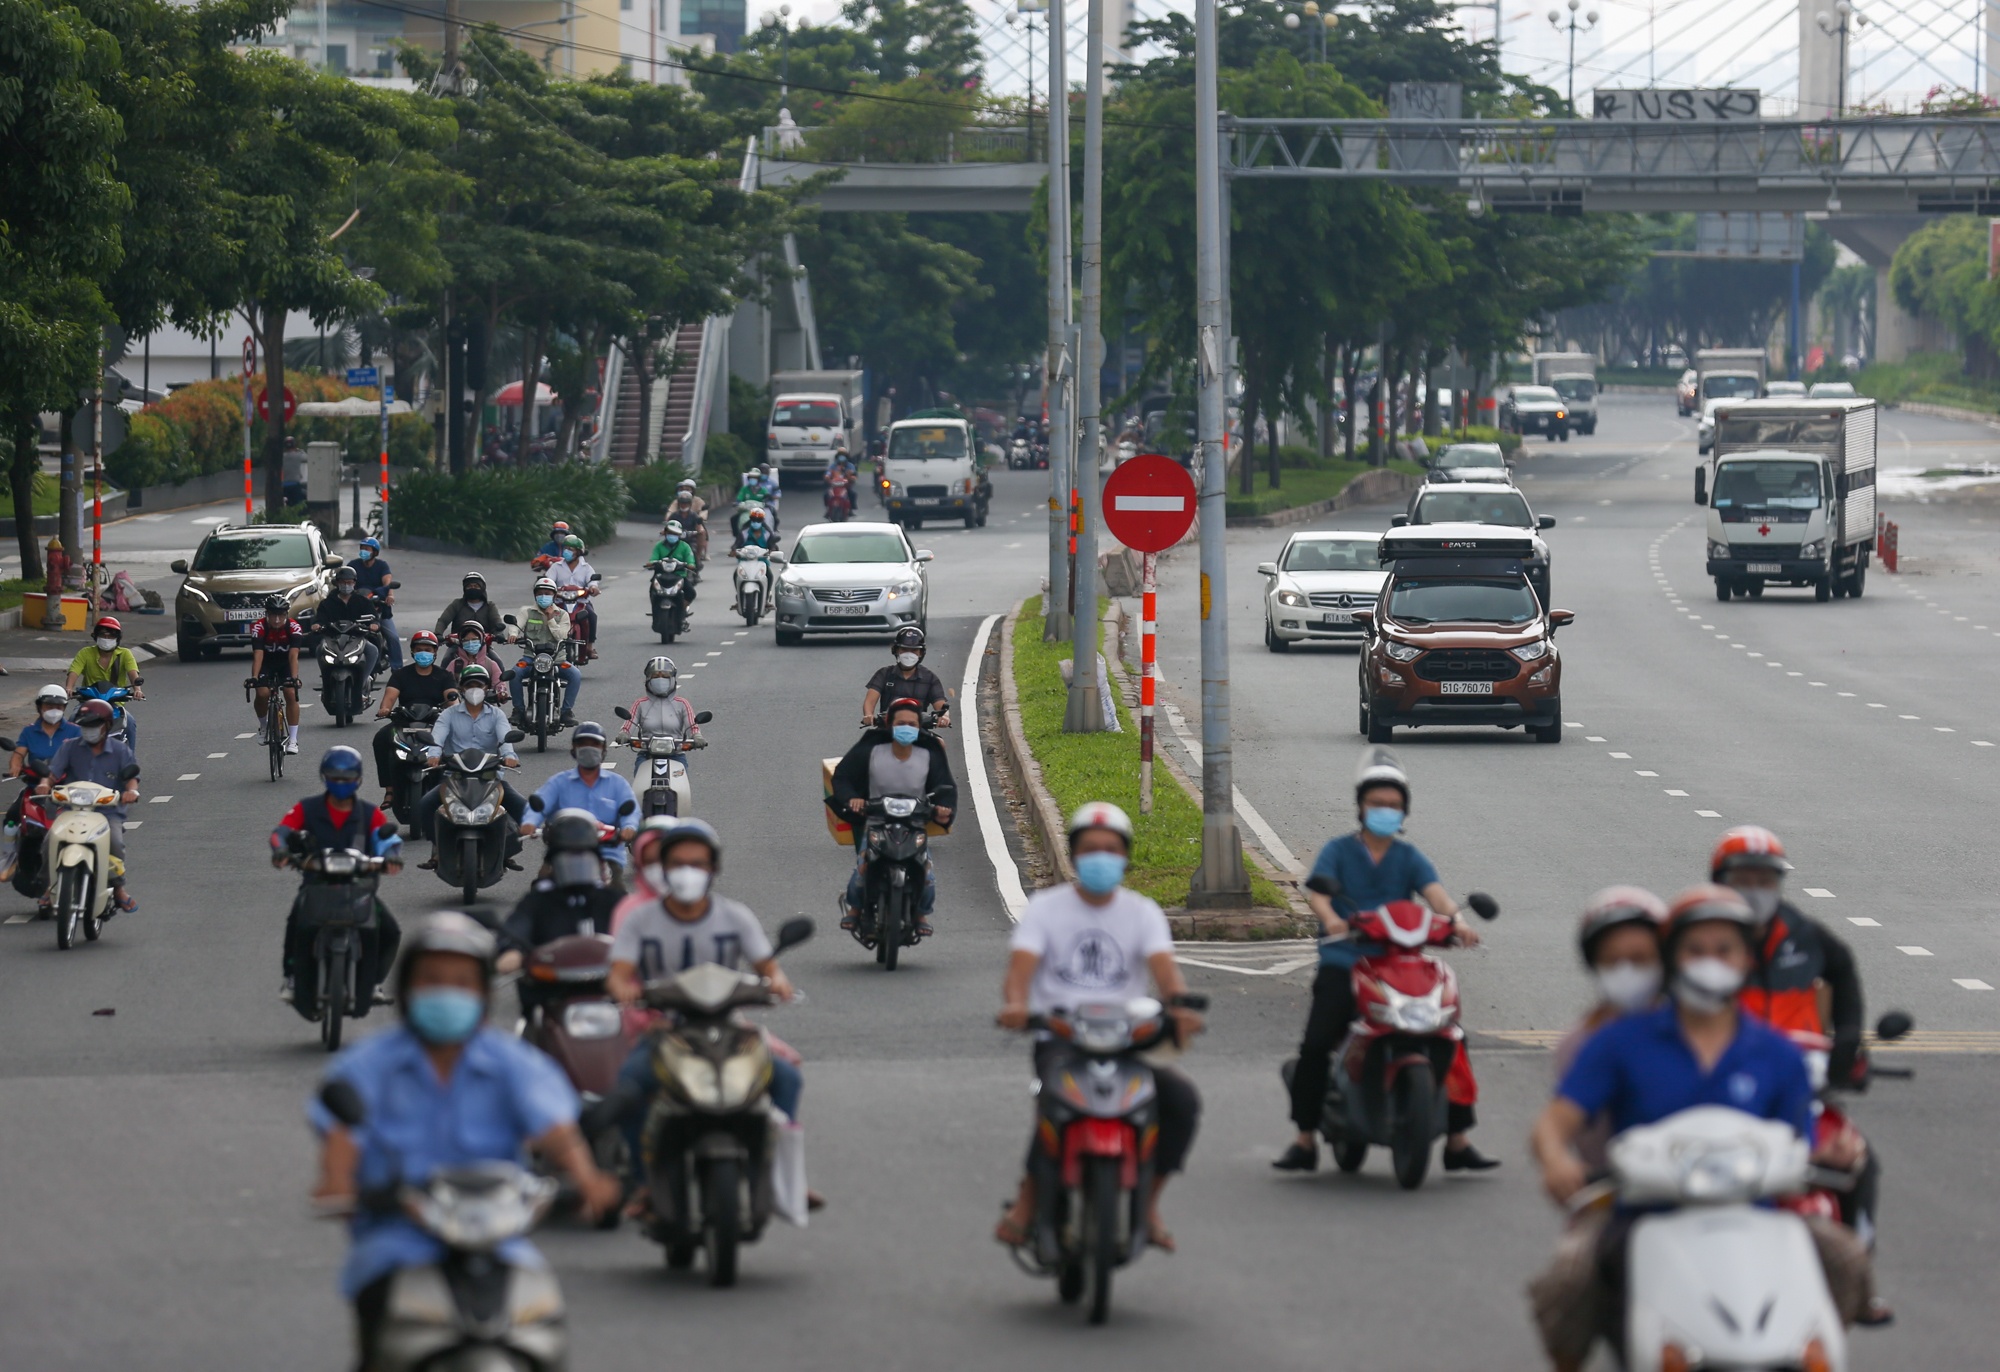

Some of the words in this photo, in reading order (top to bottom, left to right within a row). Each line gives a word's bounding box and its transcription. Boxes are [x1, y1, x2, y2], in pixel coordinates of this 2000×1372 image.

[1750, 515, 1779, 523] ISUZU
[829, 606, 864, 614] 56P-9580
[1426, 661, 1510, 671] FORD
[1442, 682, 1491, 693] 51G-760.76
